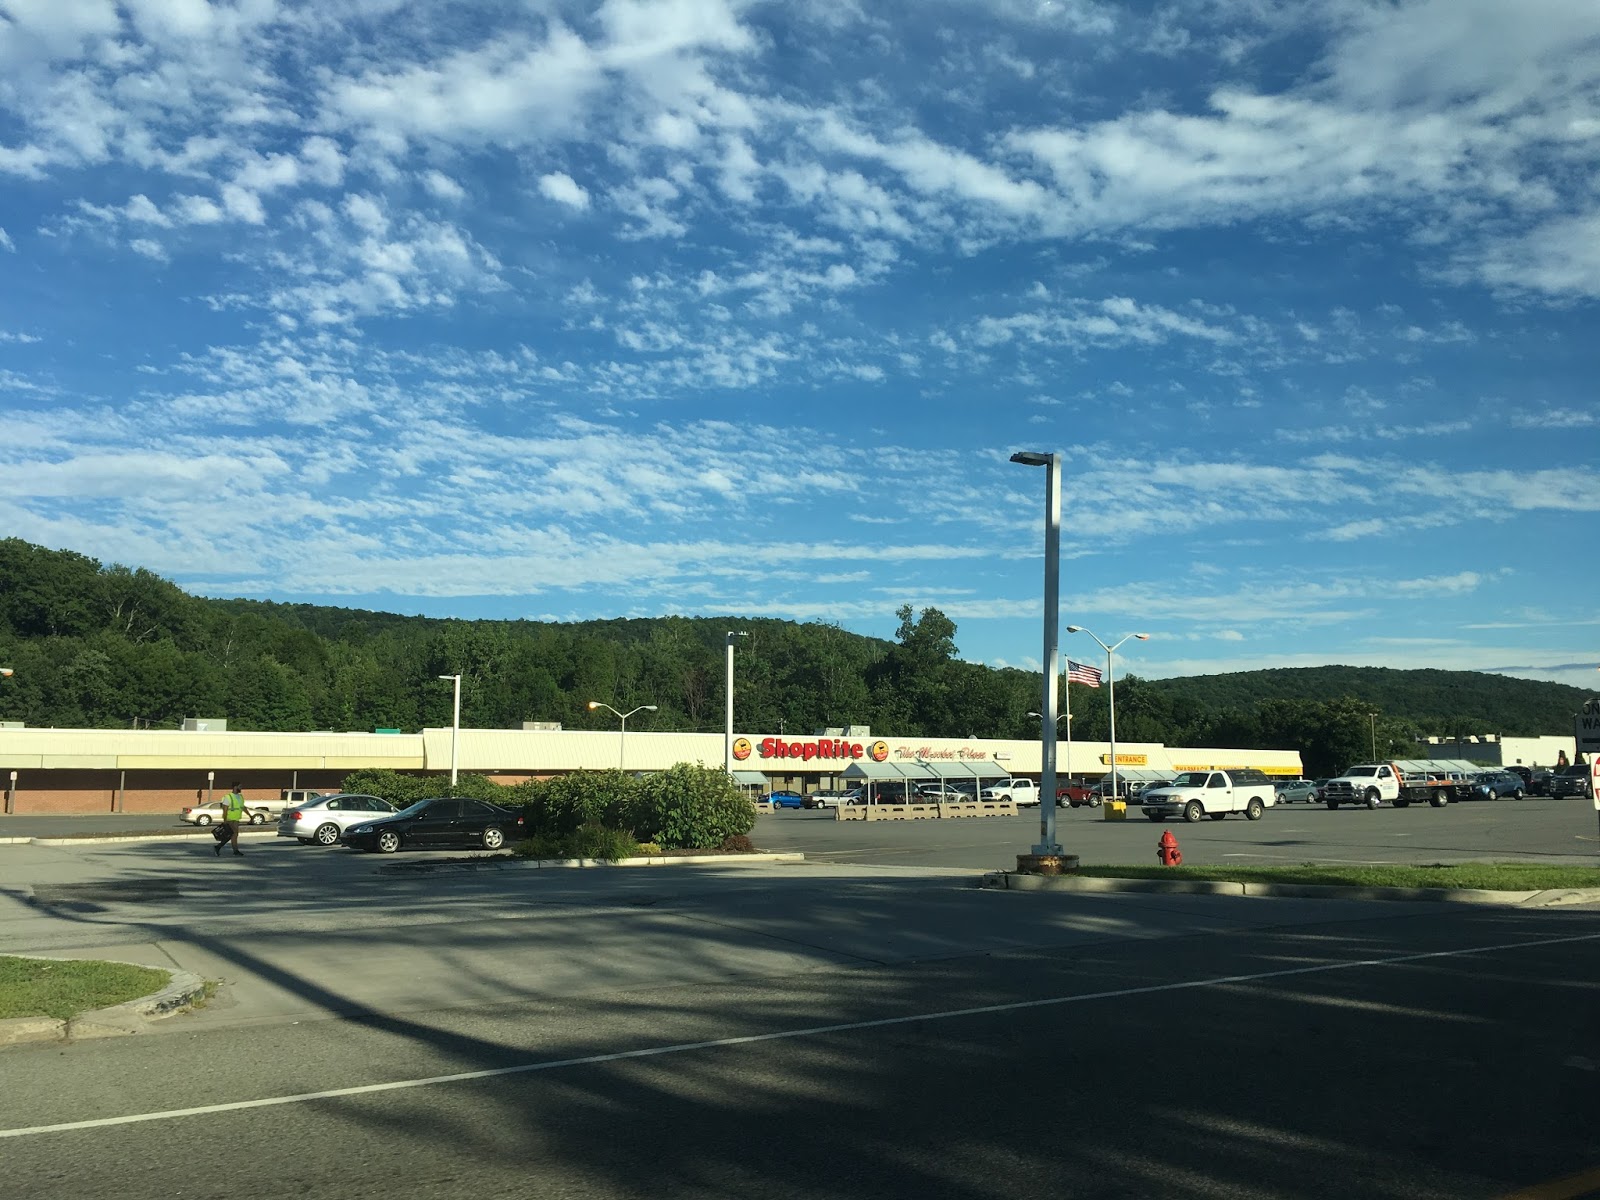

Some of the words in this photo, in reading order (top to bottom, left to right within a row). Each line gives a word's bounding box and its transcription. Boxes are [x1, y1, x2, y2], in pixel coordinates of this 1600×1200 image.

[1582, 703, 1600, 715] ON
[1582, 717, 1600, 730] WA
[761, 737, 863, 761] ShopRite
[1115, 755, 1145, 764] ENTRANCE
